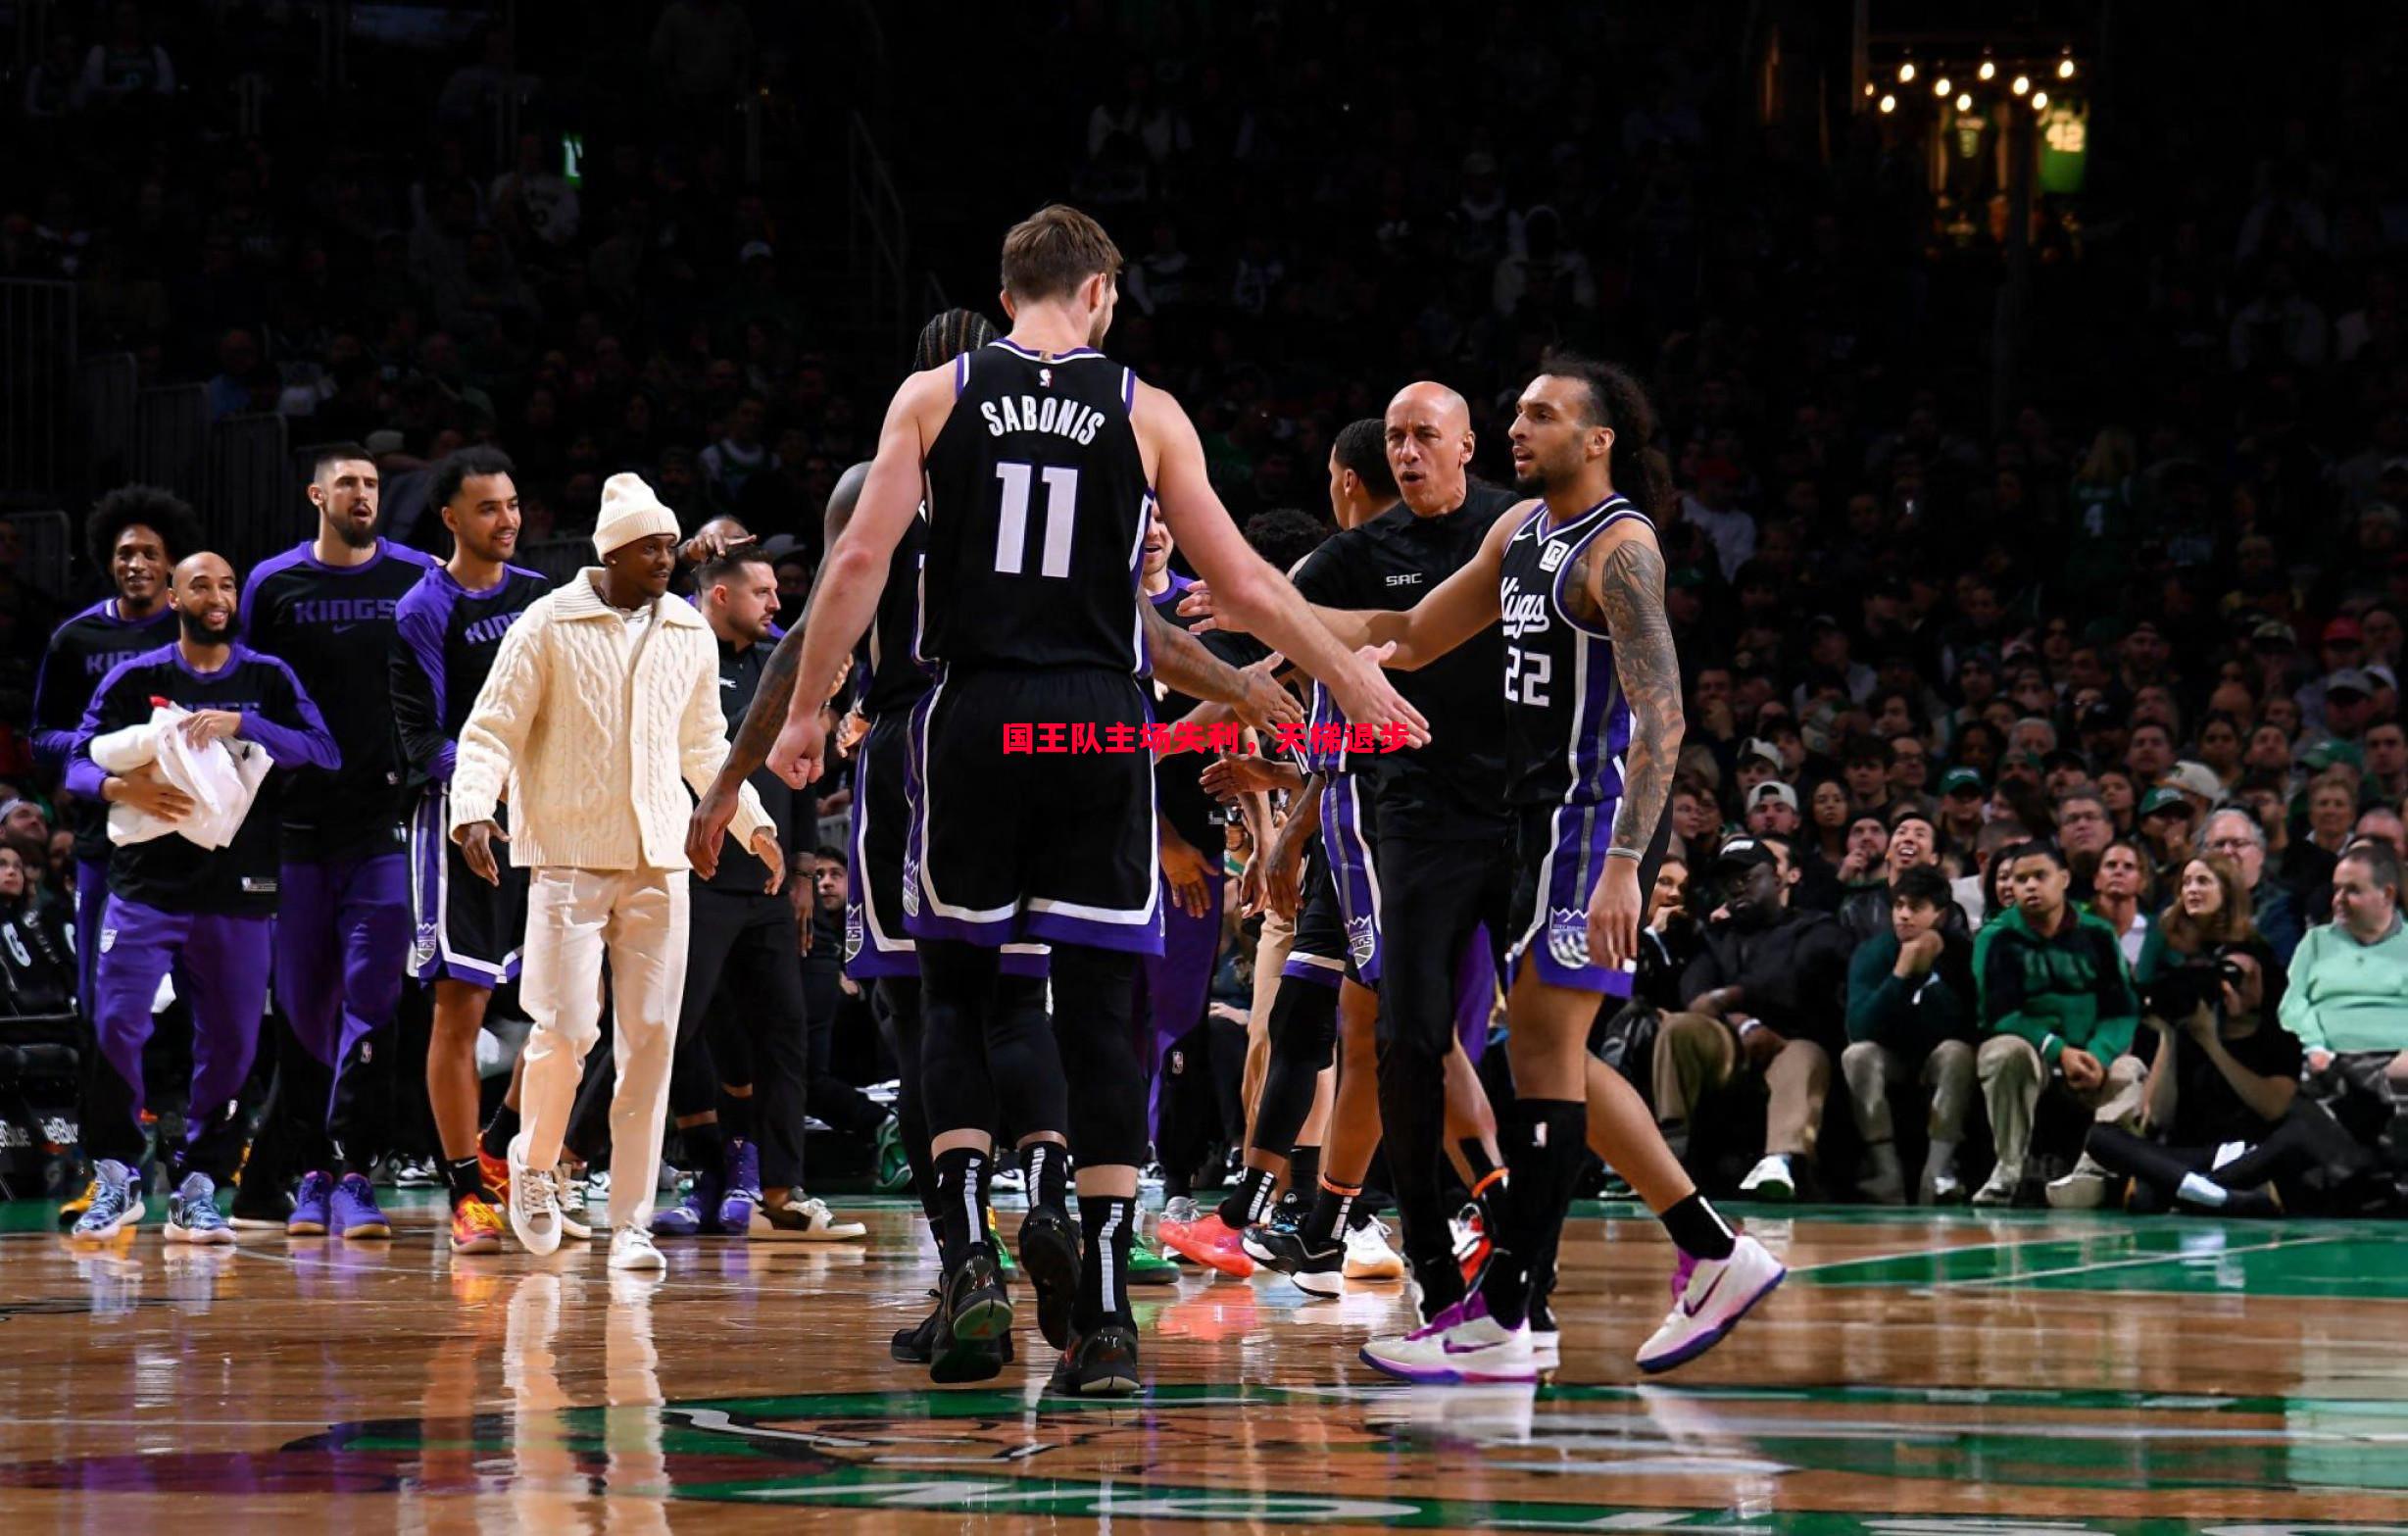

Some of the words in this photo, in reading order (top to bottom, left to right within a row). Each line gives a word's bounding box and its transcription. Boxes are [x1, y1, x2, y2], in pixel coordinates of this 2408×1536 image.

[980, 395, 1106, 447] SABONIS
[994, 461, 1079, 578] 11
[1385, 572, 1423, 586] SAC
[296, 600, 396, 624] KINGS
[465, 611, 525, 644] KIN
[1504, 645, 1550, 707] 22
